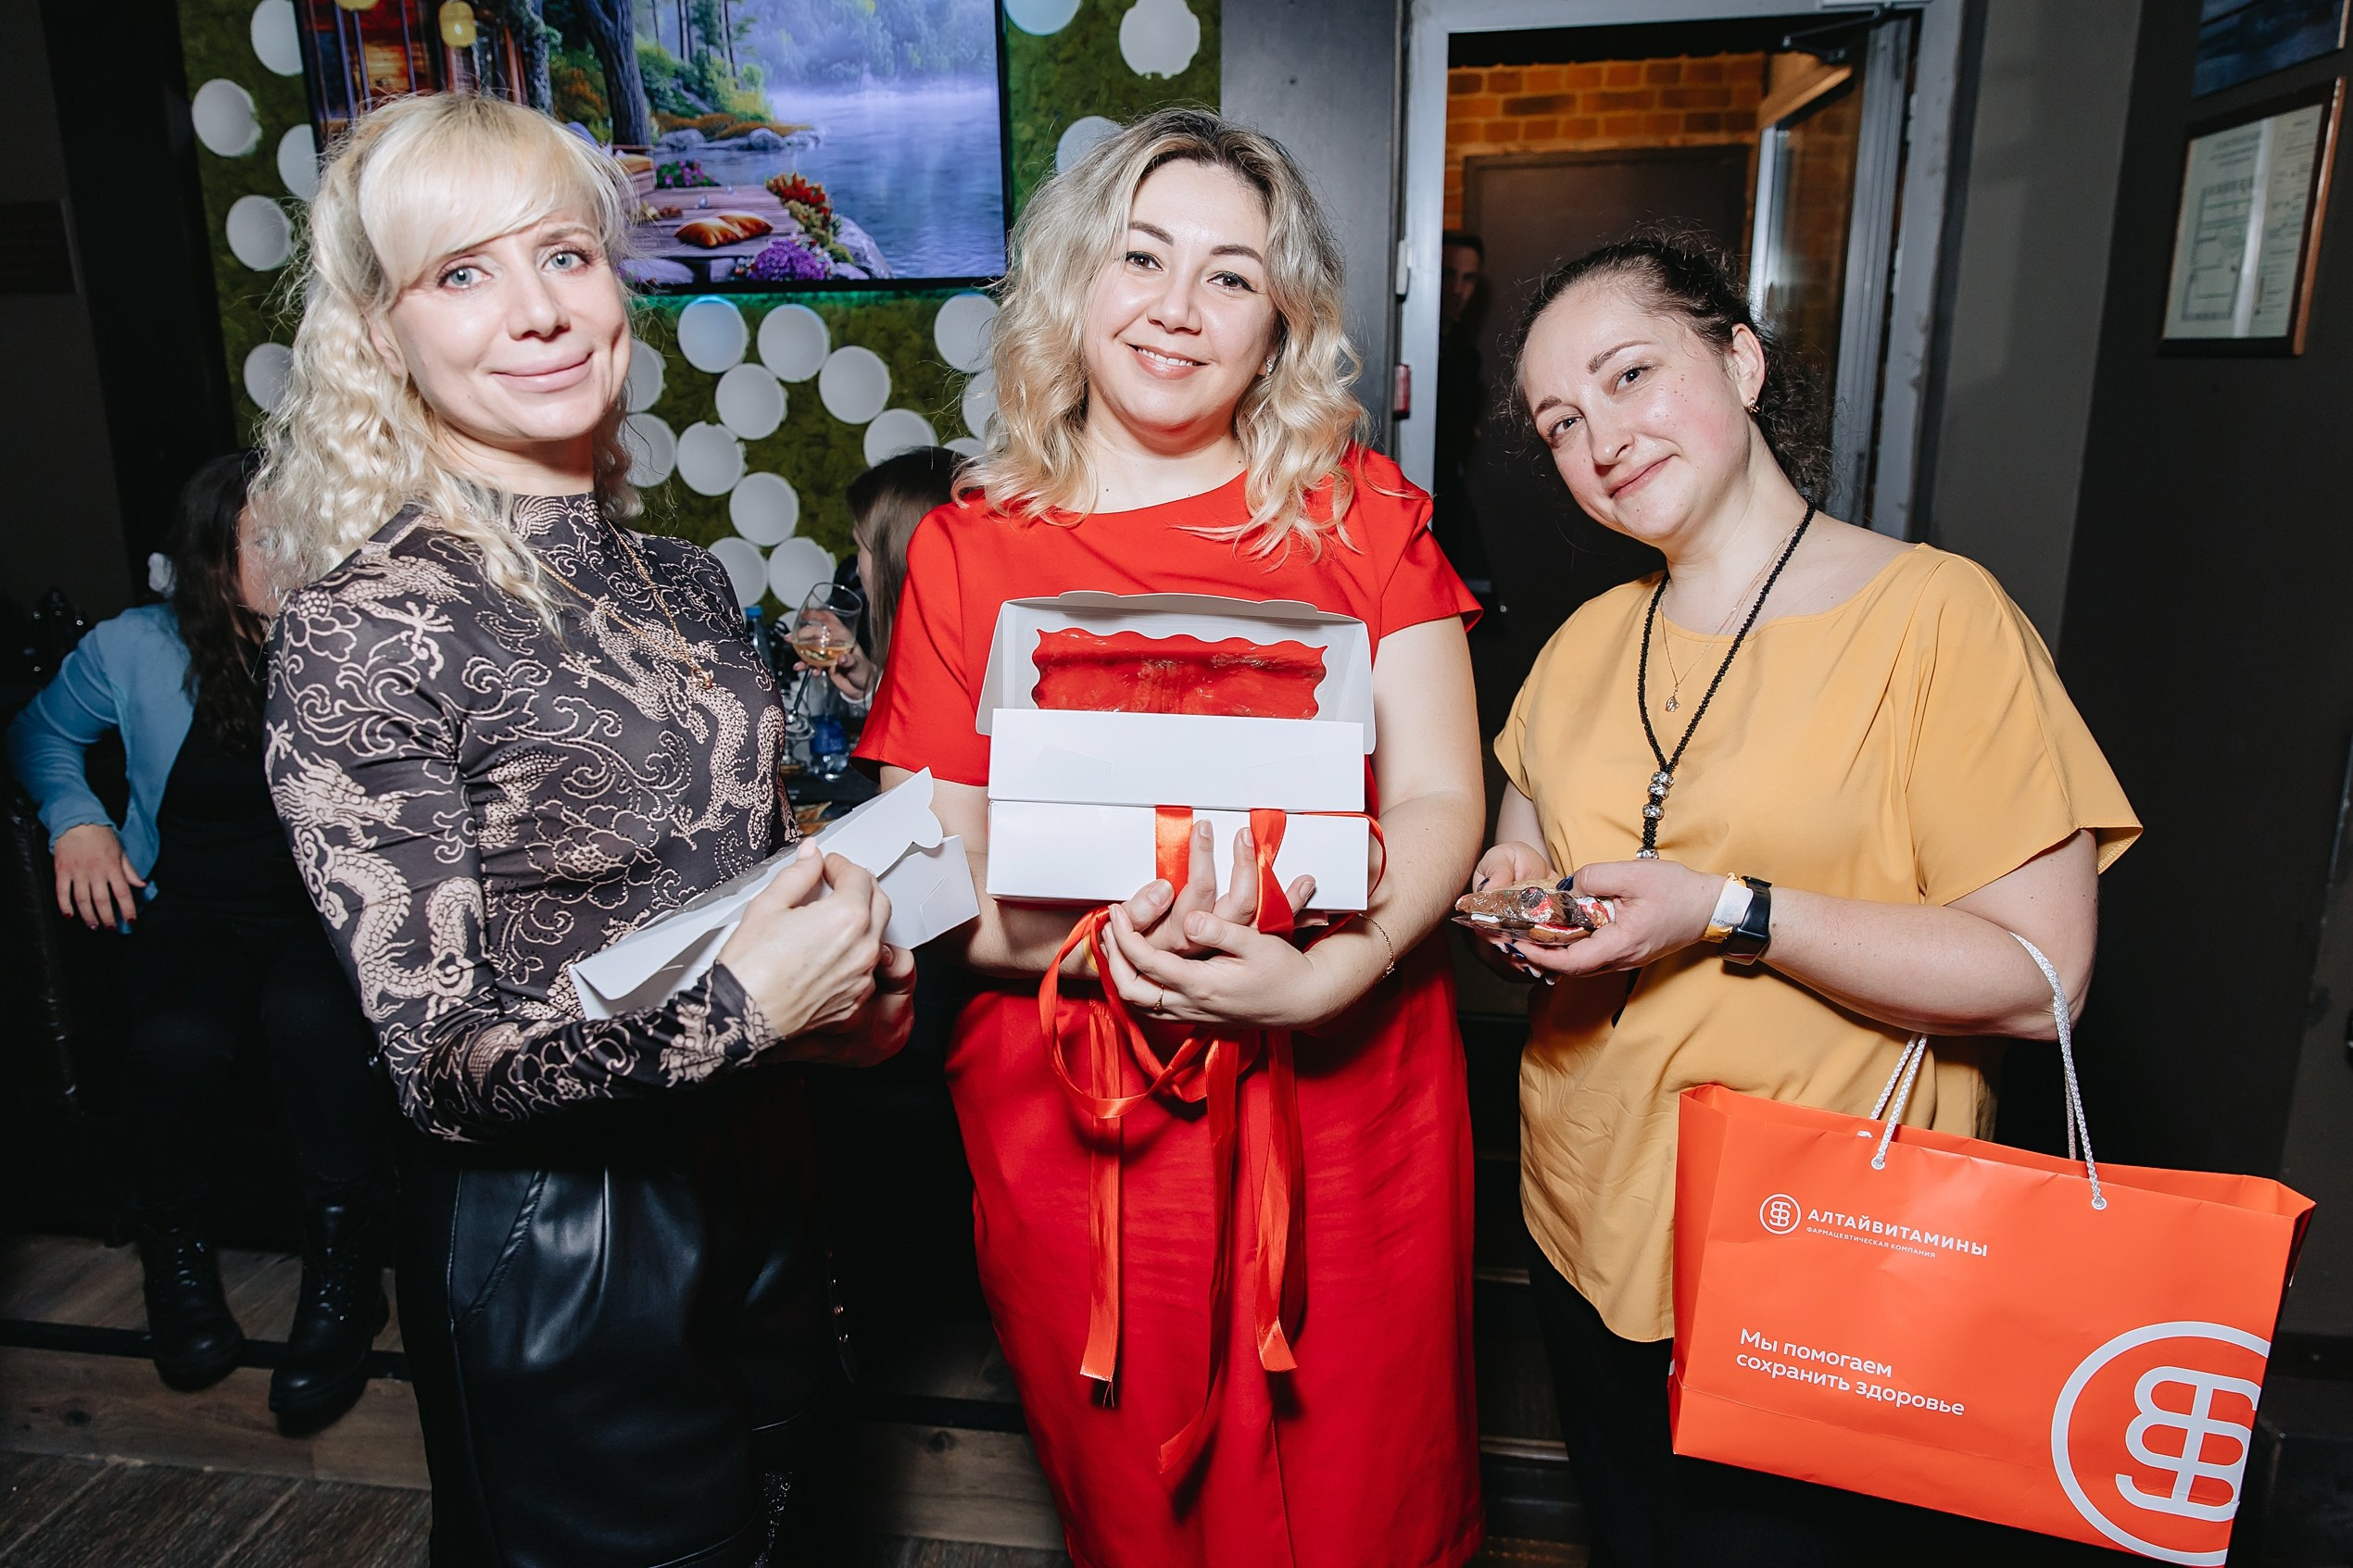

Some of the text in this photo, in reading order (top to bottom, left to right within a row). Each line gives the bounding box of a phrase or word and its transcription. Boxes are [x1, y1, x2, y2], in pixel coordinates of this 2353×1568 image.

[1806, 1226, 1936, 1259] ФАРМАЦЕВТИЧЕСКАЯ КОМПАНИЯ
[1807, 1209, 1988, 1257] АЛТАЙВИТАМИНЫ
[1740, 1328, 1893, 1378] Мы помогаем
[1736, 1353, 1965, 1416] сохранить здоровье
